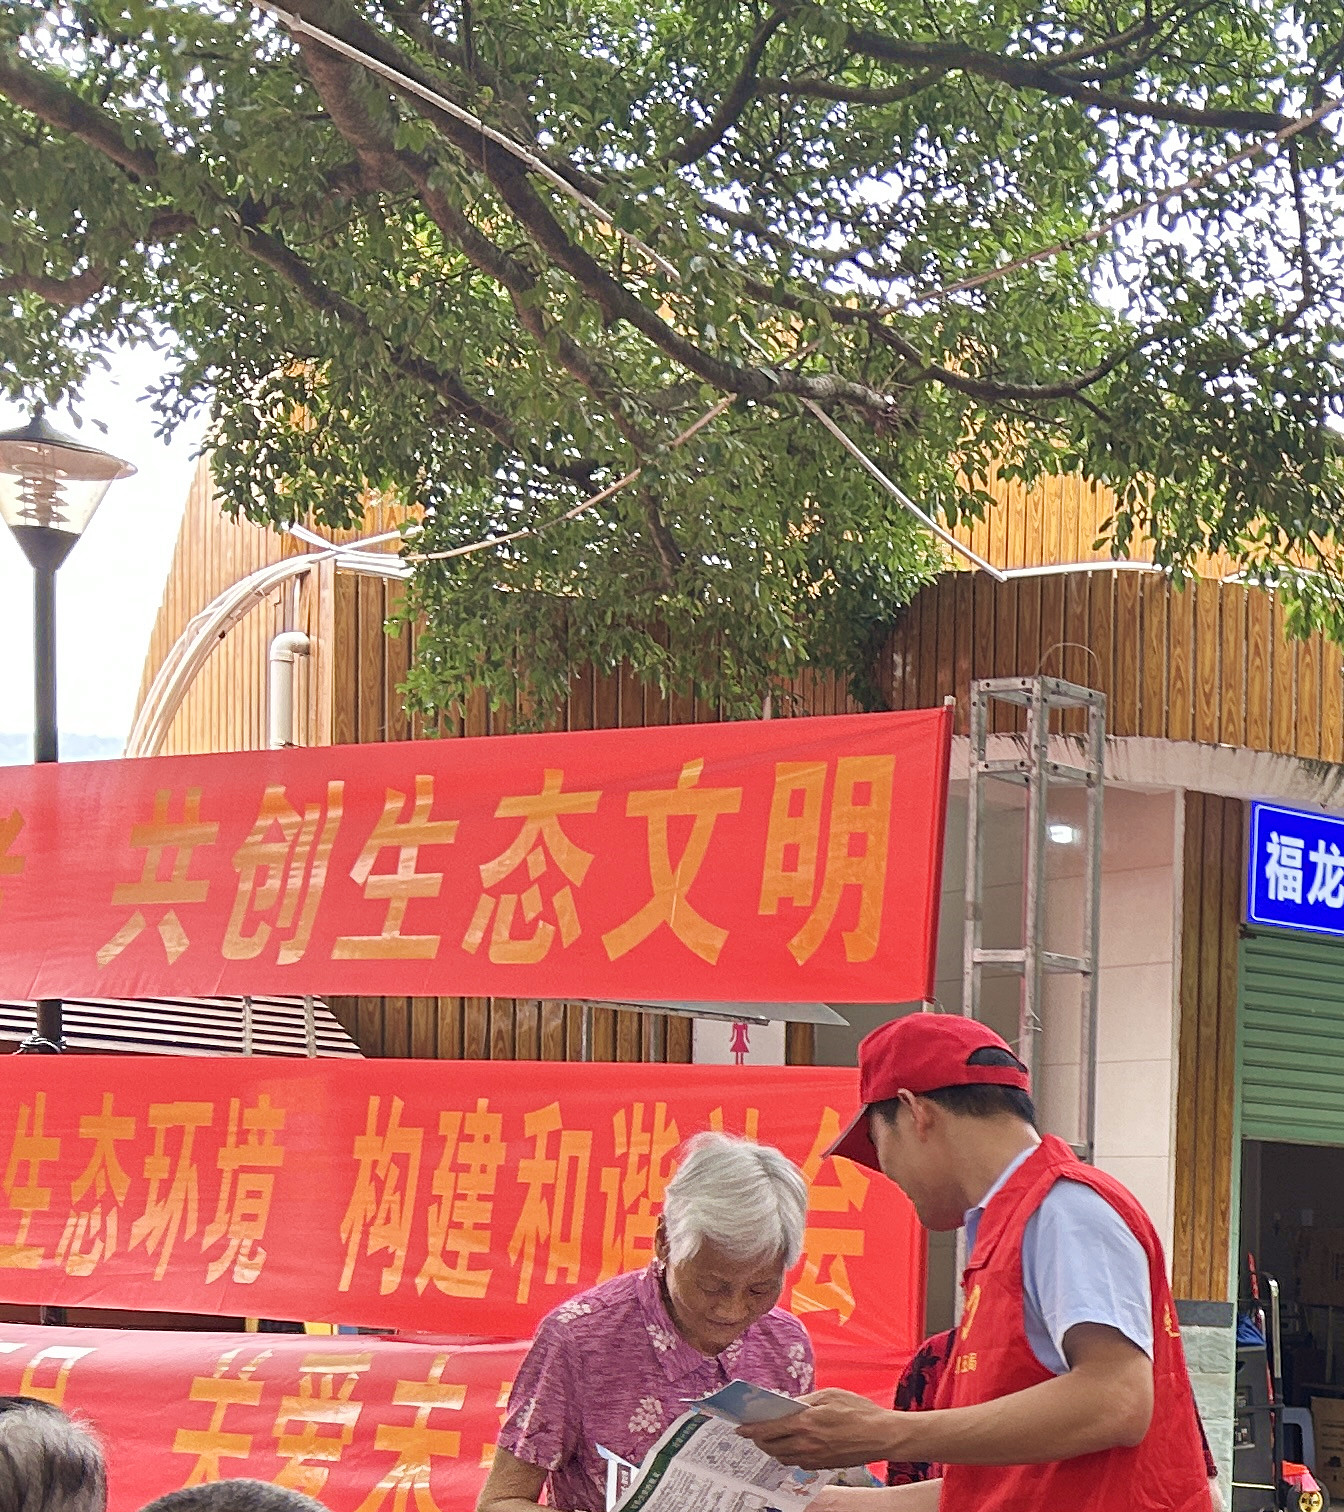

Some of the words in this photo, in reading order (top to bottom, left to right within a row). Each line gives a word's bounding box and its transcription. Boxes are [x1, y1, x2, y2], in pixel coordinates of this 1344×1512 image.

[96, 754, 897, 968] 共创生态文明
[0, 1091, 287, 1285] 生态环境
[338, 1095, 871, 1327] 构建和谐会
